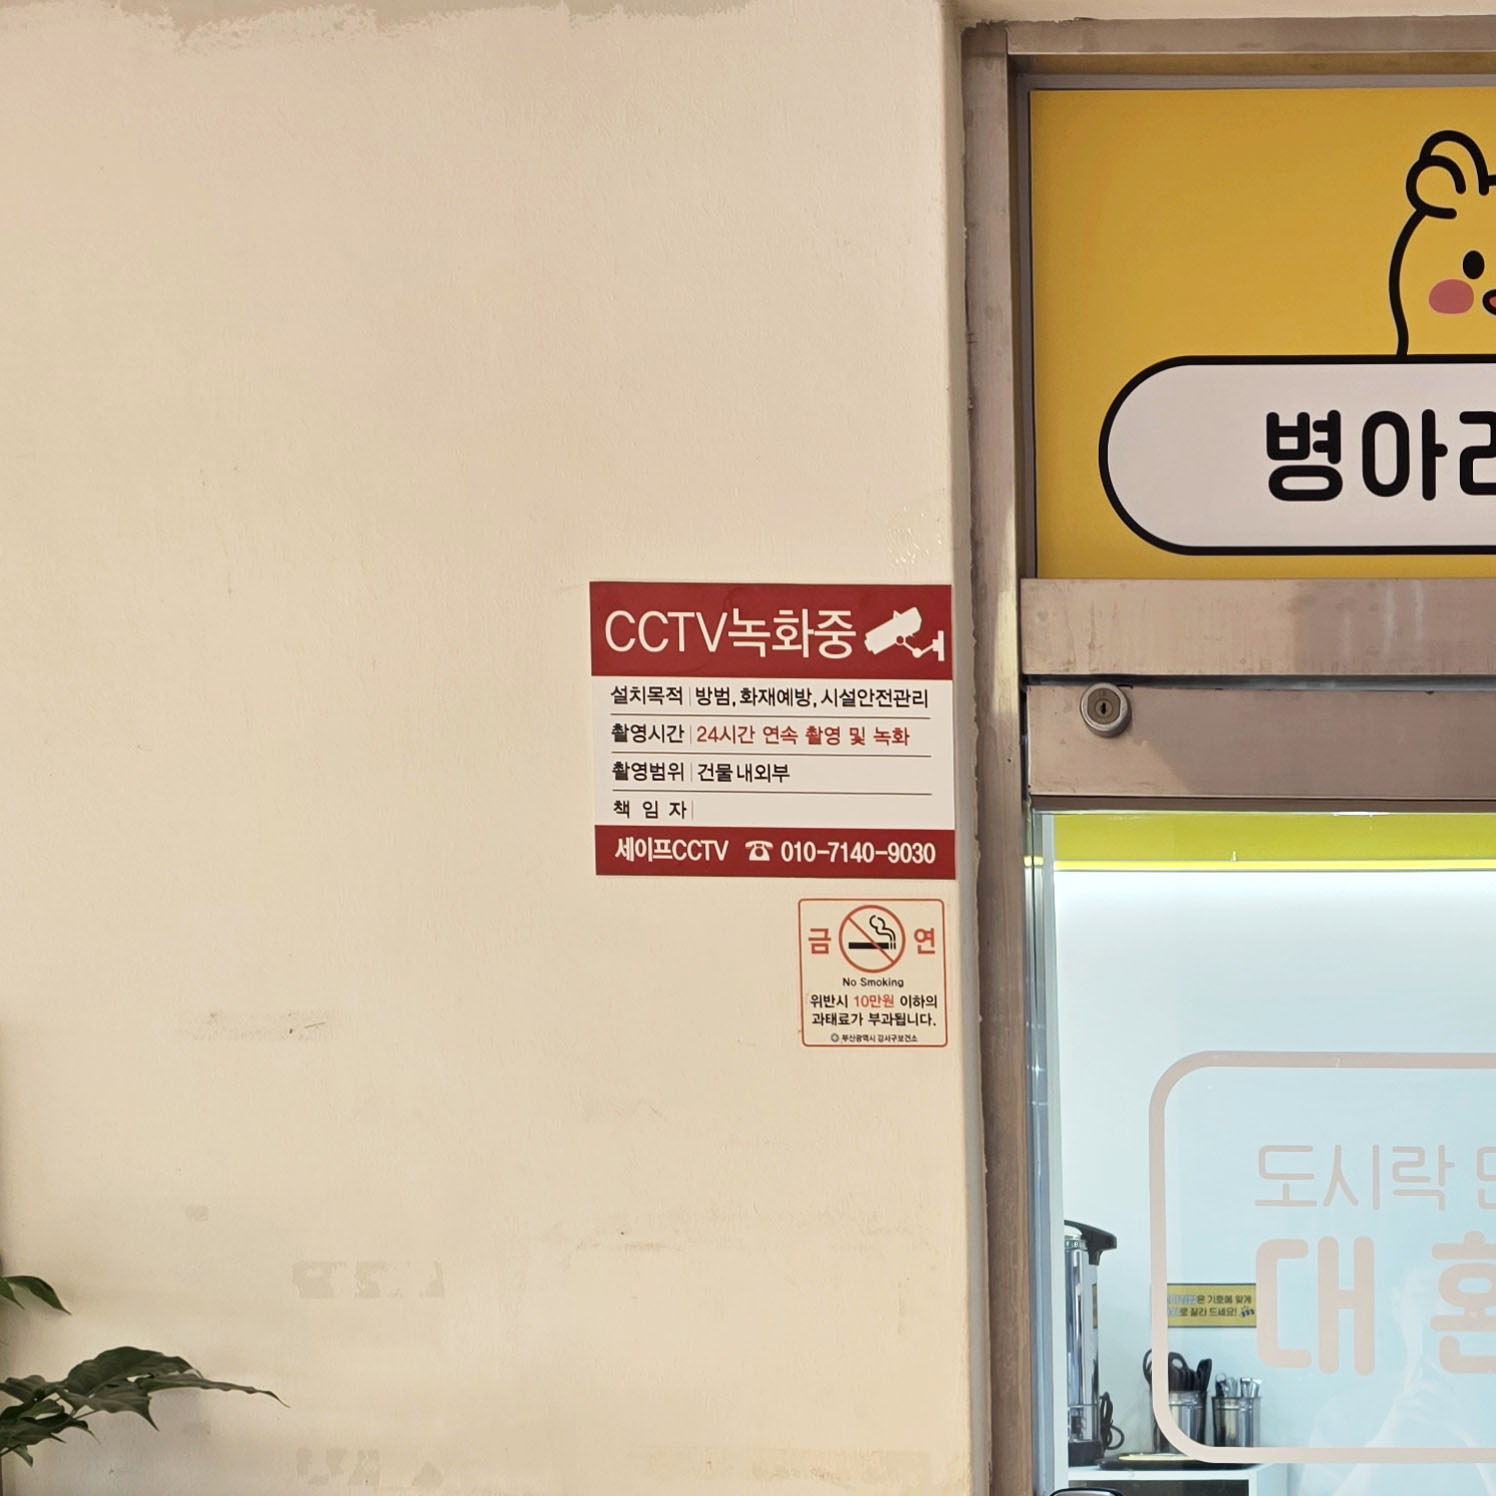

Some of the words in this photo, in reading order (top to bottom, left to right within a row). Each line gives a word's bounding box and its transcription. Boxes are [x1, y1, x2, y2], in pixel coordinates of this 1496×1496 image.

[604, 607, 857, 660] CCTV녹화중
[610, 685, 683, 706] 설치목적
[695, 686, 736, 708] 방범,
[739, 687, 818, 709] 화재예방,
[820, 688, 929, 709] 시설안전관리
[611, 723, 685, 744] 촬영시간
[696, 724, 756, 745] 24시간
[762, 725, 799, 746] 연속
[804, 725, 842, 746] 촬영
[849, 726, 866, 746] 및
[873, 726, 910, 747] 녹화
[612, 761, 685, 782] 촬영범위
[697, 762, 733, 783] 건물
[736, 763, 791, 784] 내외부
[613, 800, 631, 819] 책
[642, 801, 659, 820] 임
[668, 801, 687, 820] 자
[614, 836, 729, 863] 세이프CCTV
[780, 840, 937, 864] 010-7140-9030
[808, 928, 832, 955] 금
[914, 928, 936, 955] 연
[842, 978, 857, 987] No
[860, 978, 904, 988] Smoking
[810, 995, 849, 1009] 위반시
[853, 995, 894, 1008] 10만원
[900, 995, 938, 1009] 이하의
[812, 1013, 863, 1026] 과태료가
[868, 1013, 937, 1027] 부과됩니다.
[1254, 1144, 1454, 1211] 도시락
